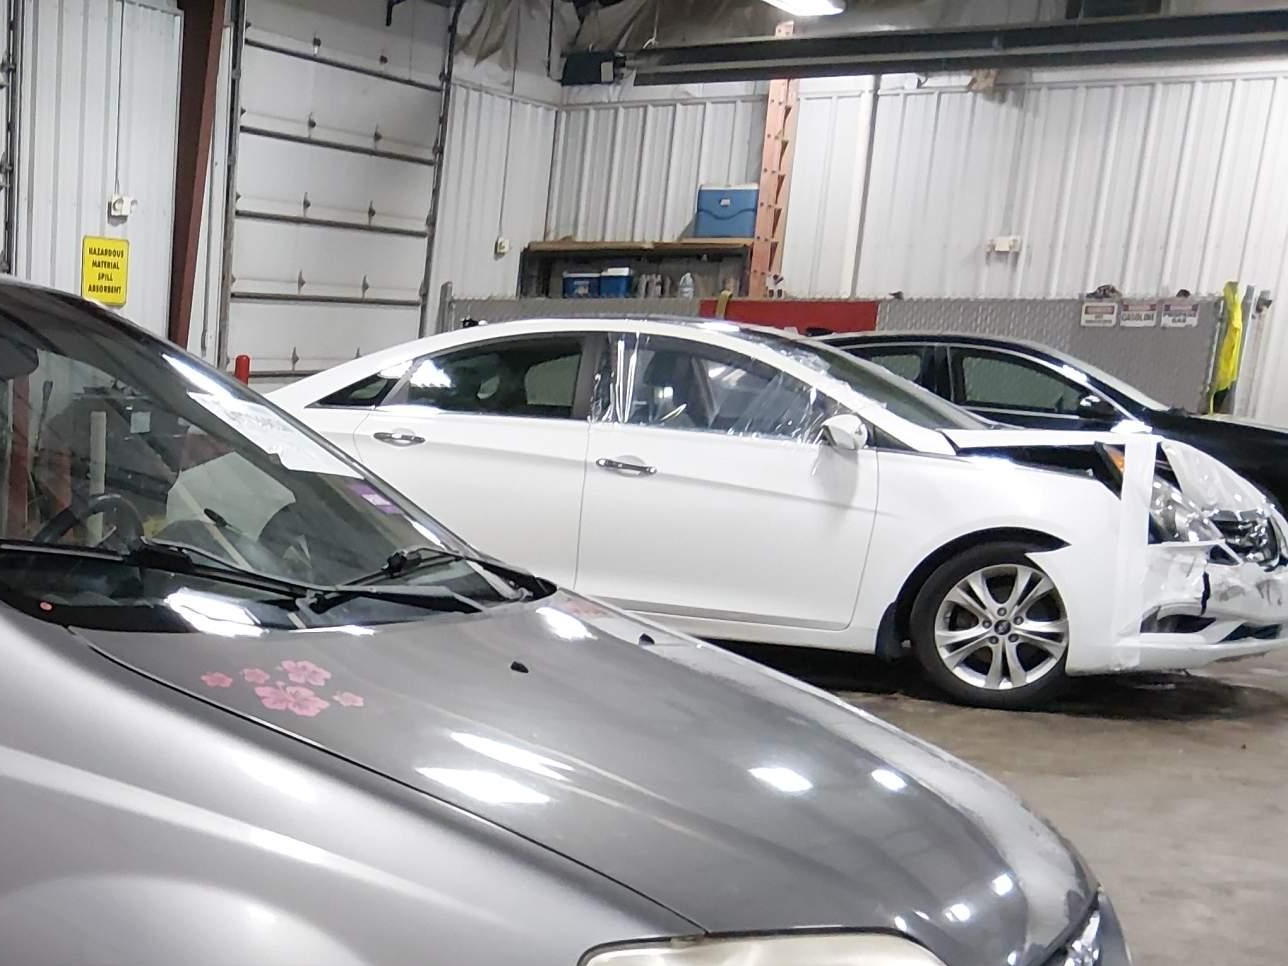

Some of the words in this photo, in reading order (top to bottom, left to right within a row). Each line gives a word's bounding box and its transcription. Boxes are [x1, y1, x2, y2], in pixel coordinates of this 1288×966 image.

[88, 247, 124, 258] HAZARDOUS
[92, 260, 120, 270] MATERIAL
[98, 272, 113, 281] SPILL
[88, 284, 122, 295] ABSORBENT
